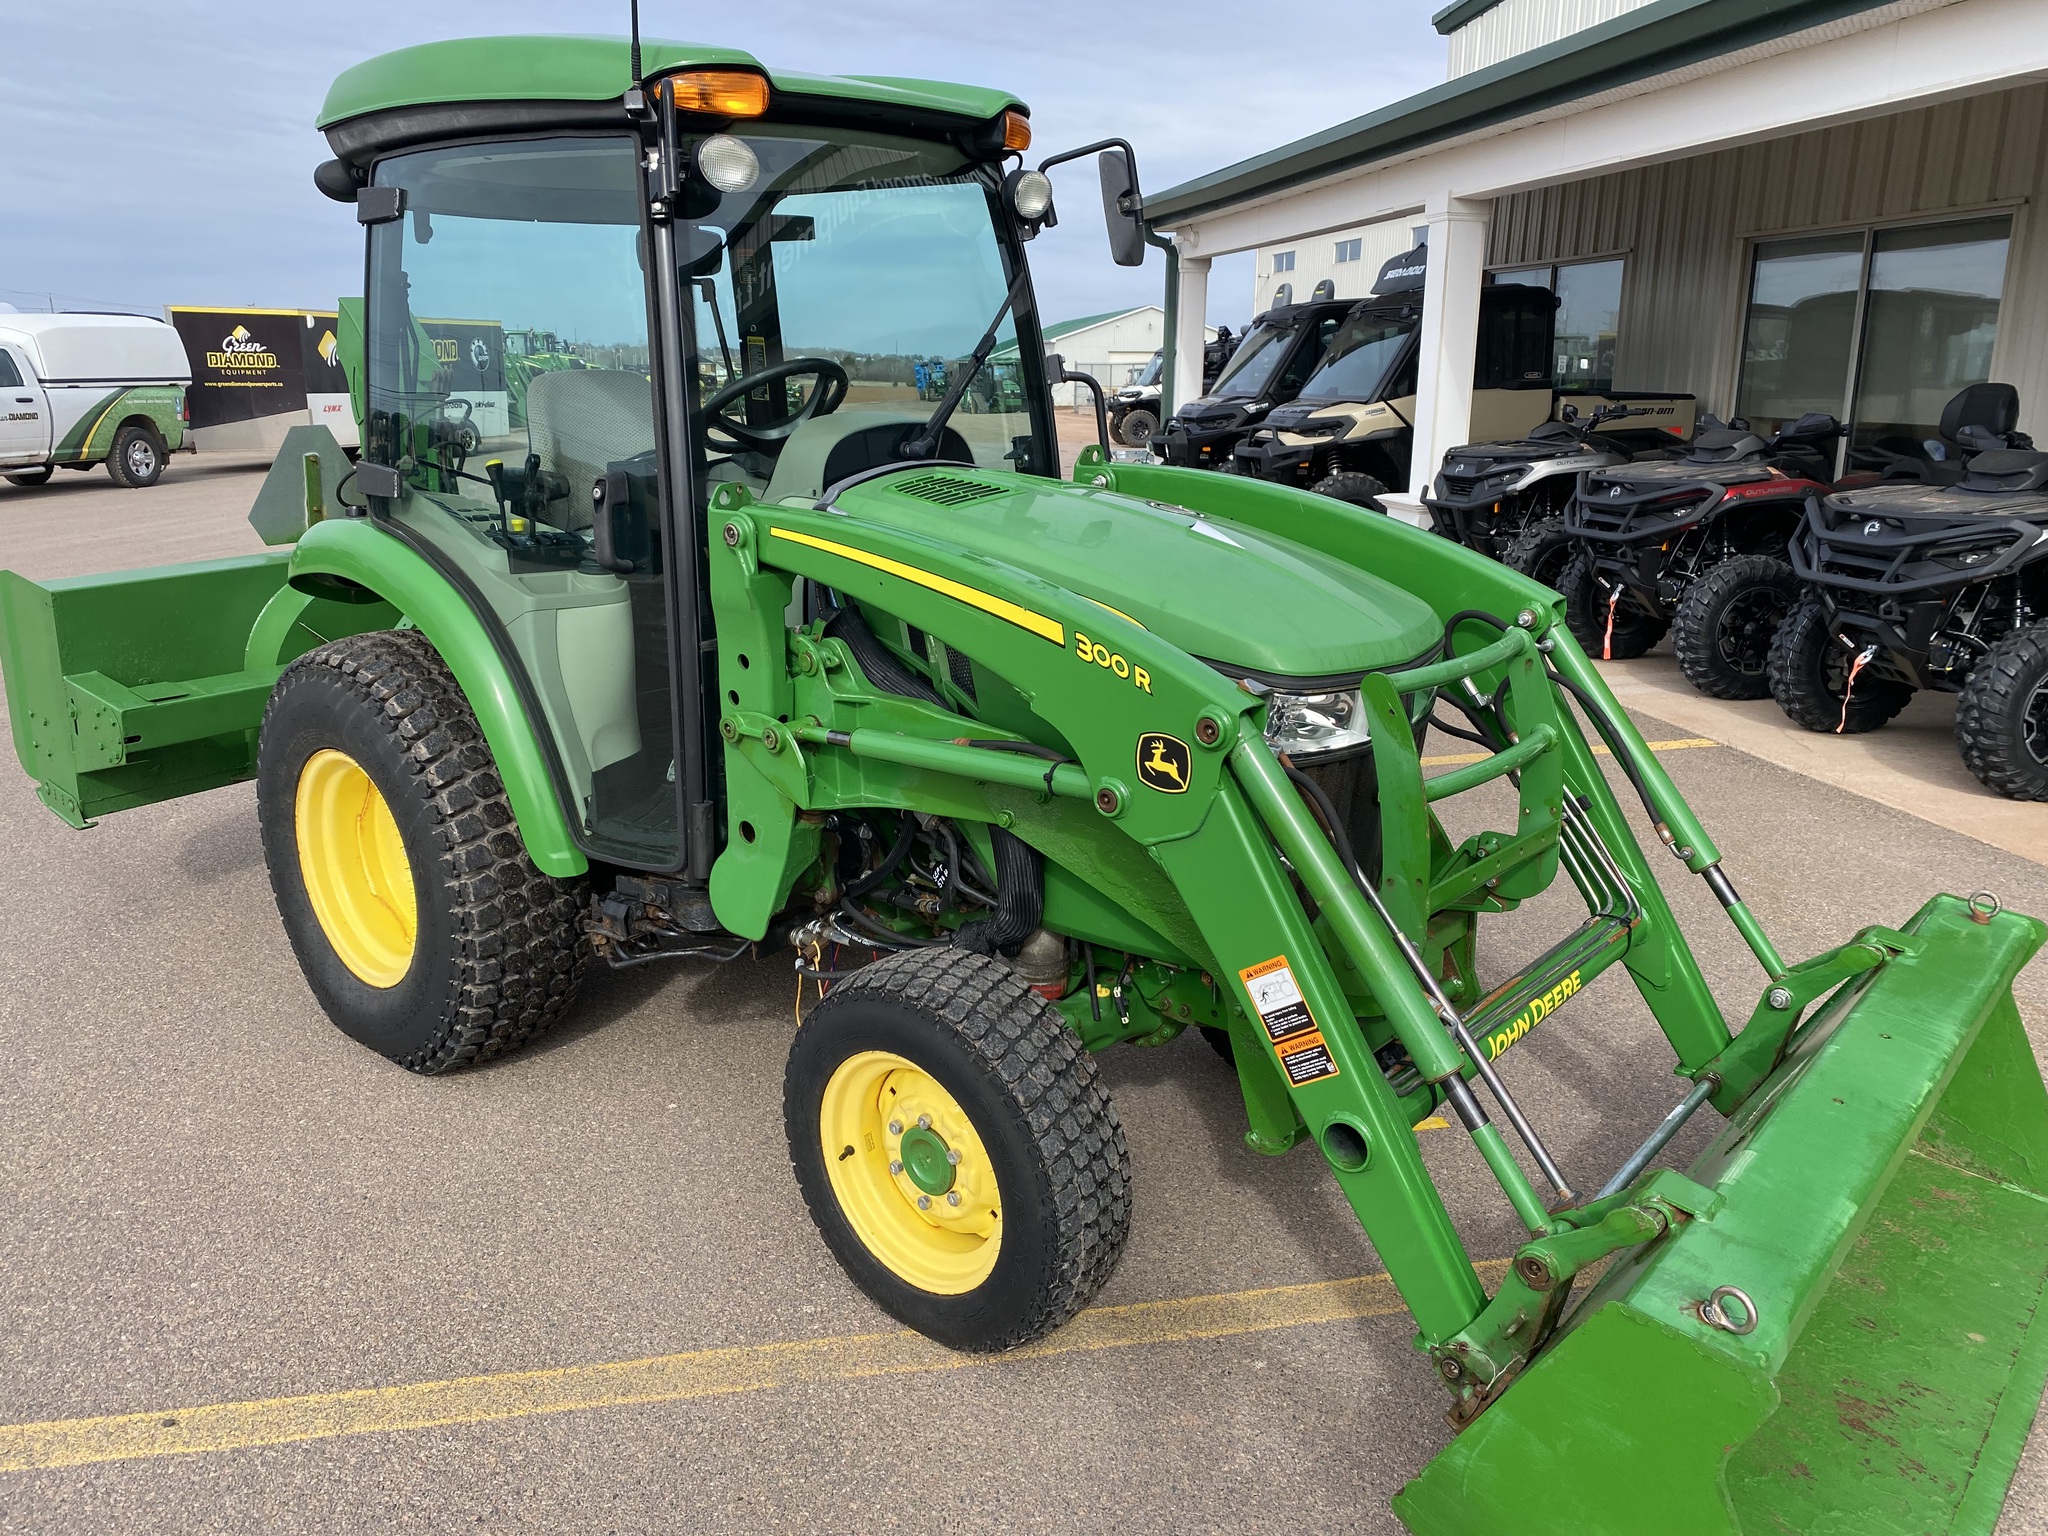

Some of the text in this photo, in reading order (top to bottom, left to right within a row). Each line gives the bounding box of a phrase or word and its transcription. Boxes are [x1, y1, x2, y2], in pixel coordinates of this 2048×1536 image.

[222, 335, 267, 357] Green
[206, 352, 277, 368] DIAMOND
[322, 404, 342, 413] LYNX
[8, 412, 39, 421] DIAMOND
[1556, 458, 1594, 466] OUTLANDER
[1746, 486, 1793, 496] OUTLANDER
[1074, 630, 1154, 697] 300 R
[1252, 960, 1282, 976] WARNING
[1486, 969, 1582, 1064] JOHN DEERE
[1288, 1037, 1319, 1051] WARNING
